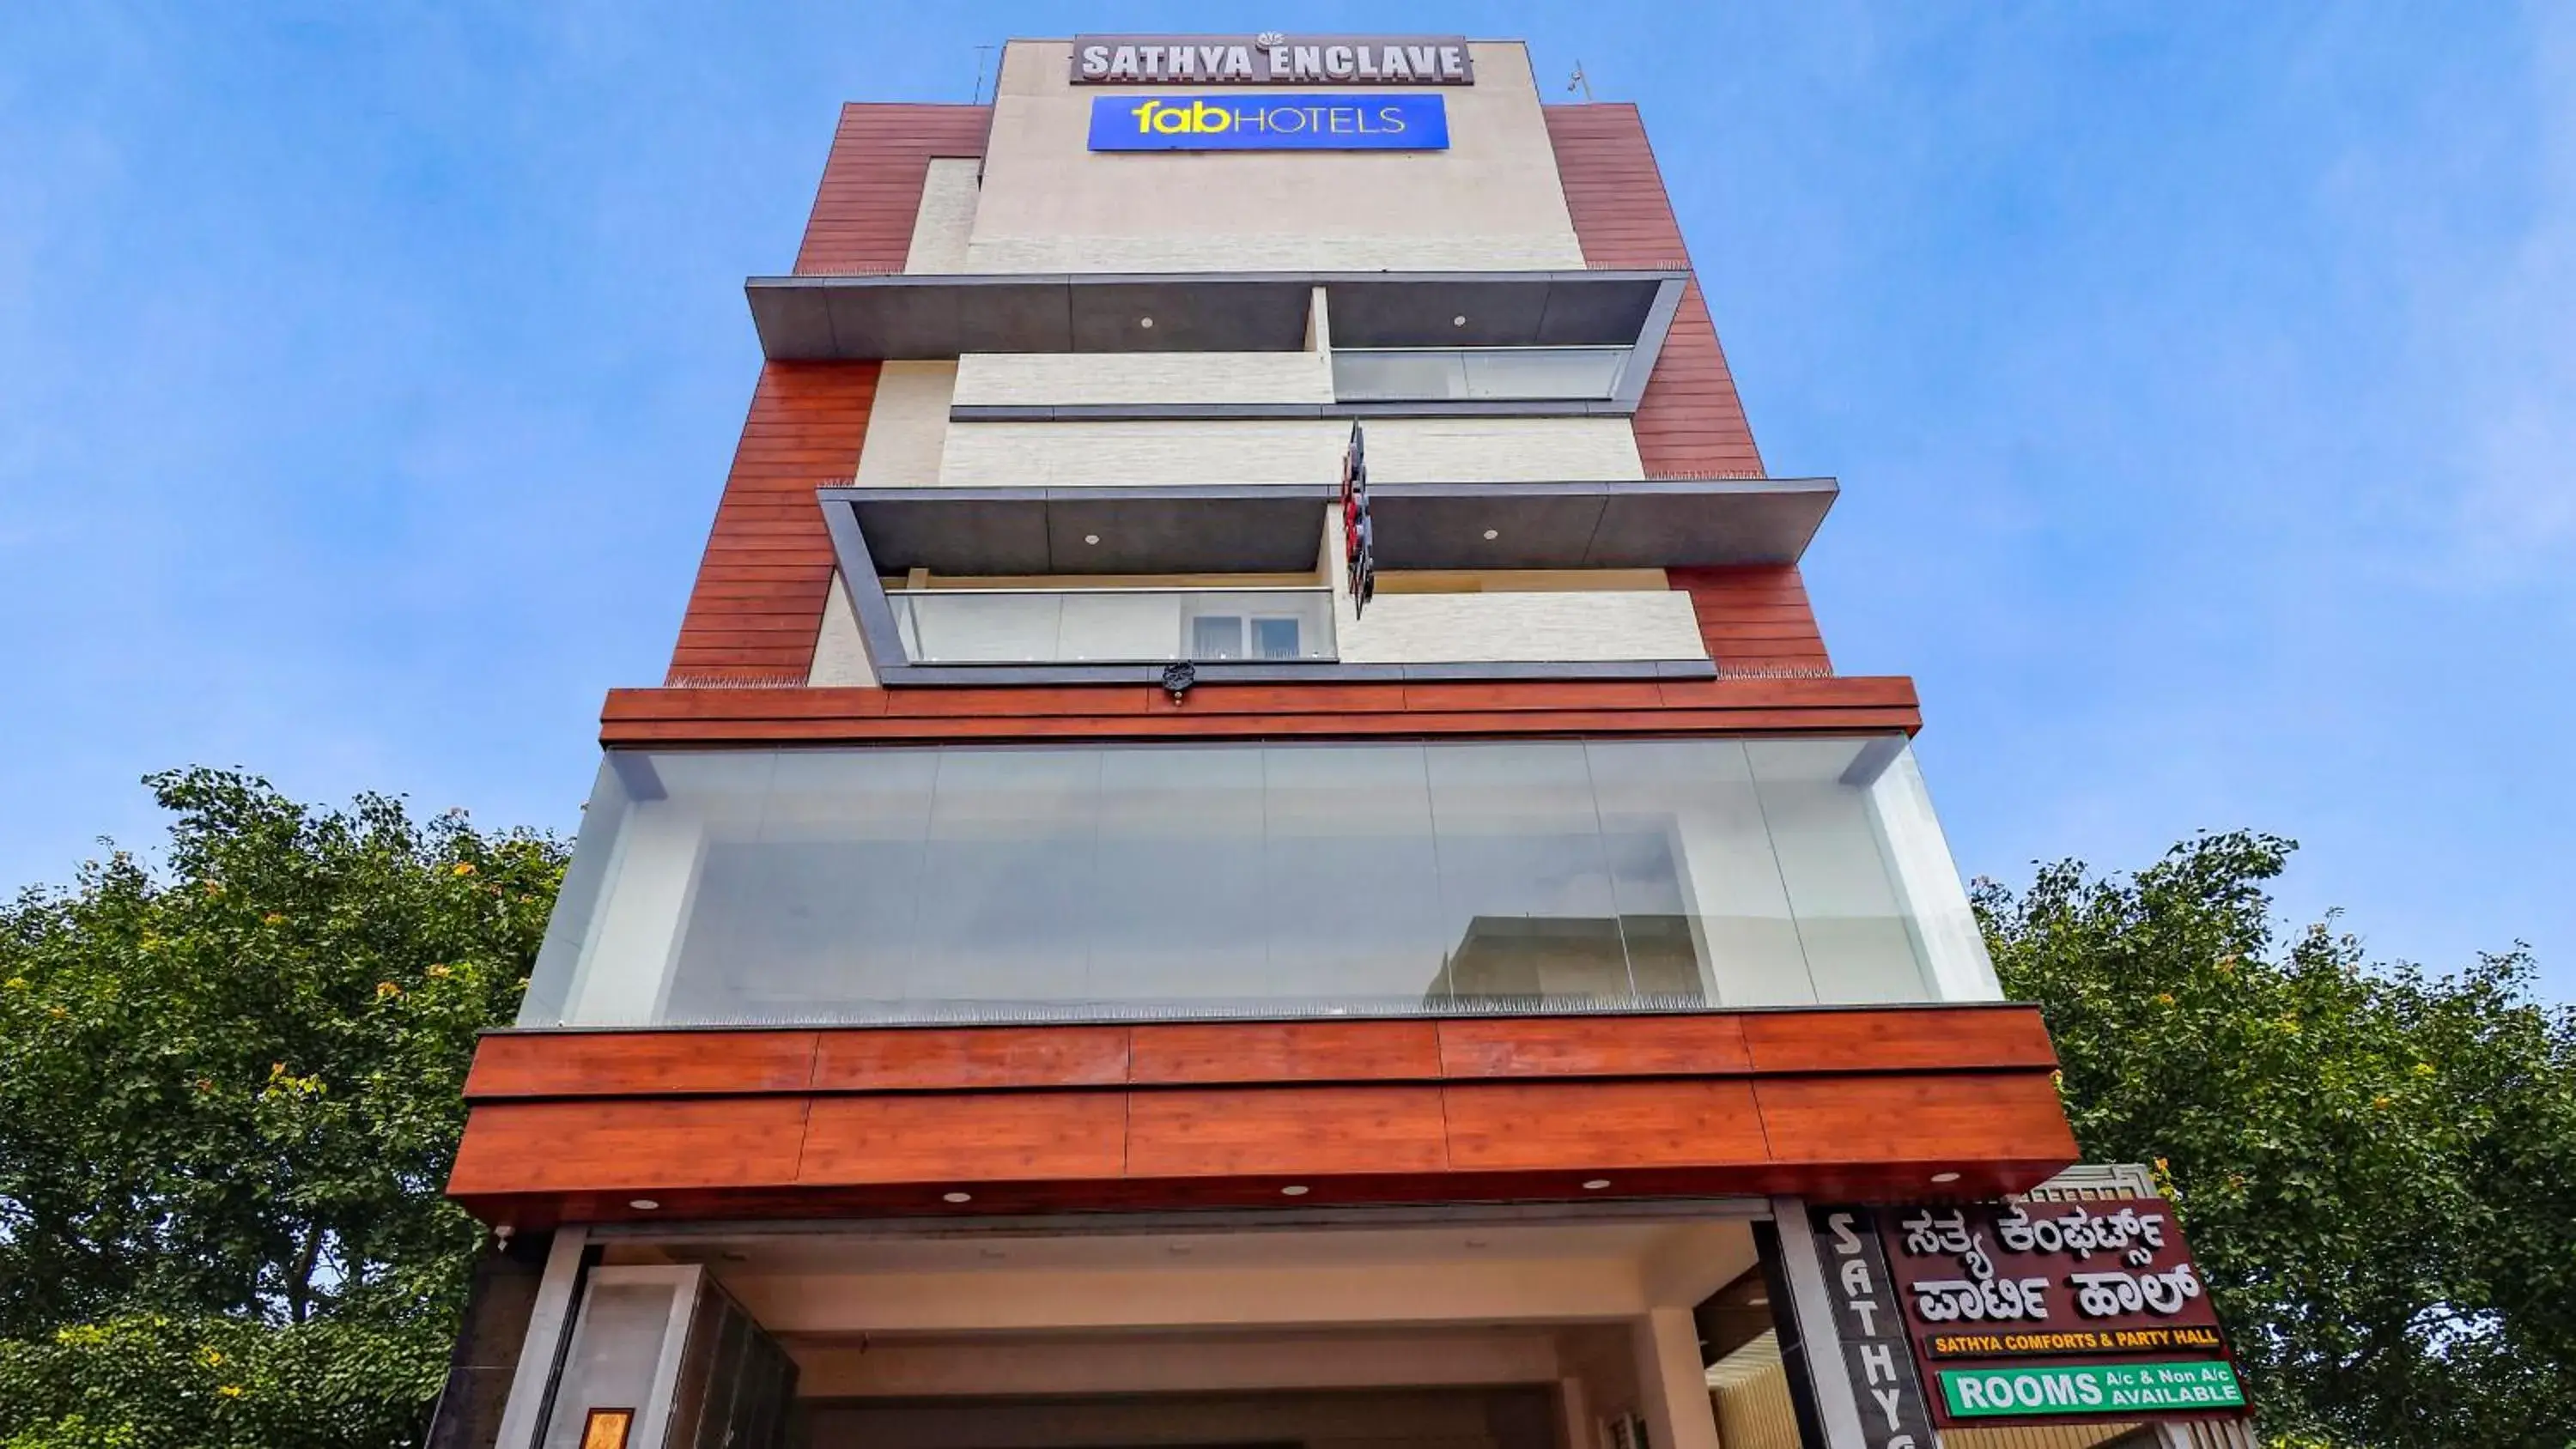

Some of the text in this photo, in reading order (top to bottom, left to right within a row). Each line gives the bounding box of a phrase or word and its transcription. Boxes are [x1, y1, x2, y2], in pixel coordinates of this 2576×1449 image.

[1083, 45, 1465, 80] SATHYA ENCLAVE
[1131, 100, 1406, 135] fabHOTELS
[1902, 1209, 1995, 1279] ಸತ್ಯ
[1913, 1263, 2201, 1321] ಪಾರ್ಟಿ ಹಾಲ್
[1935, 1329, 2220, 1353] SATHYA COMFORTS & PARTY HALL
[1956, 1373, 2103, 1409] ROOMS
[2140, 1370, 2154, 1385] &
[2160, 1369, 2195, 1383] Non
[2111, 1385, 2240, 1406] AVAILABLE
